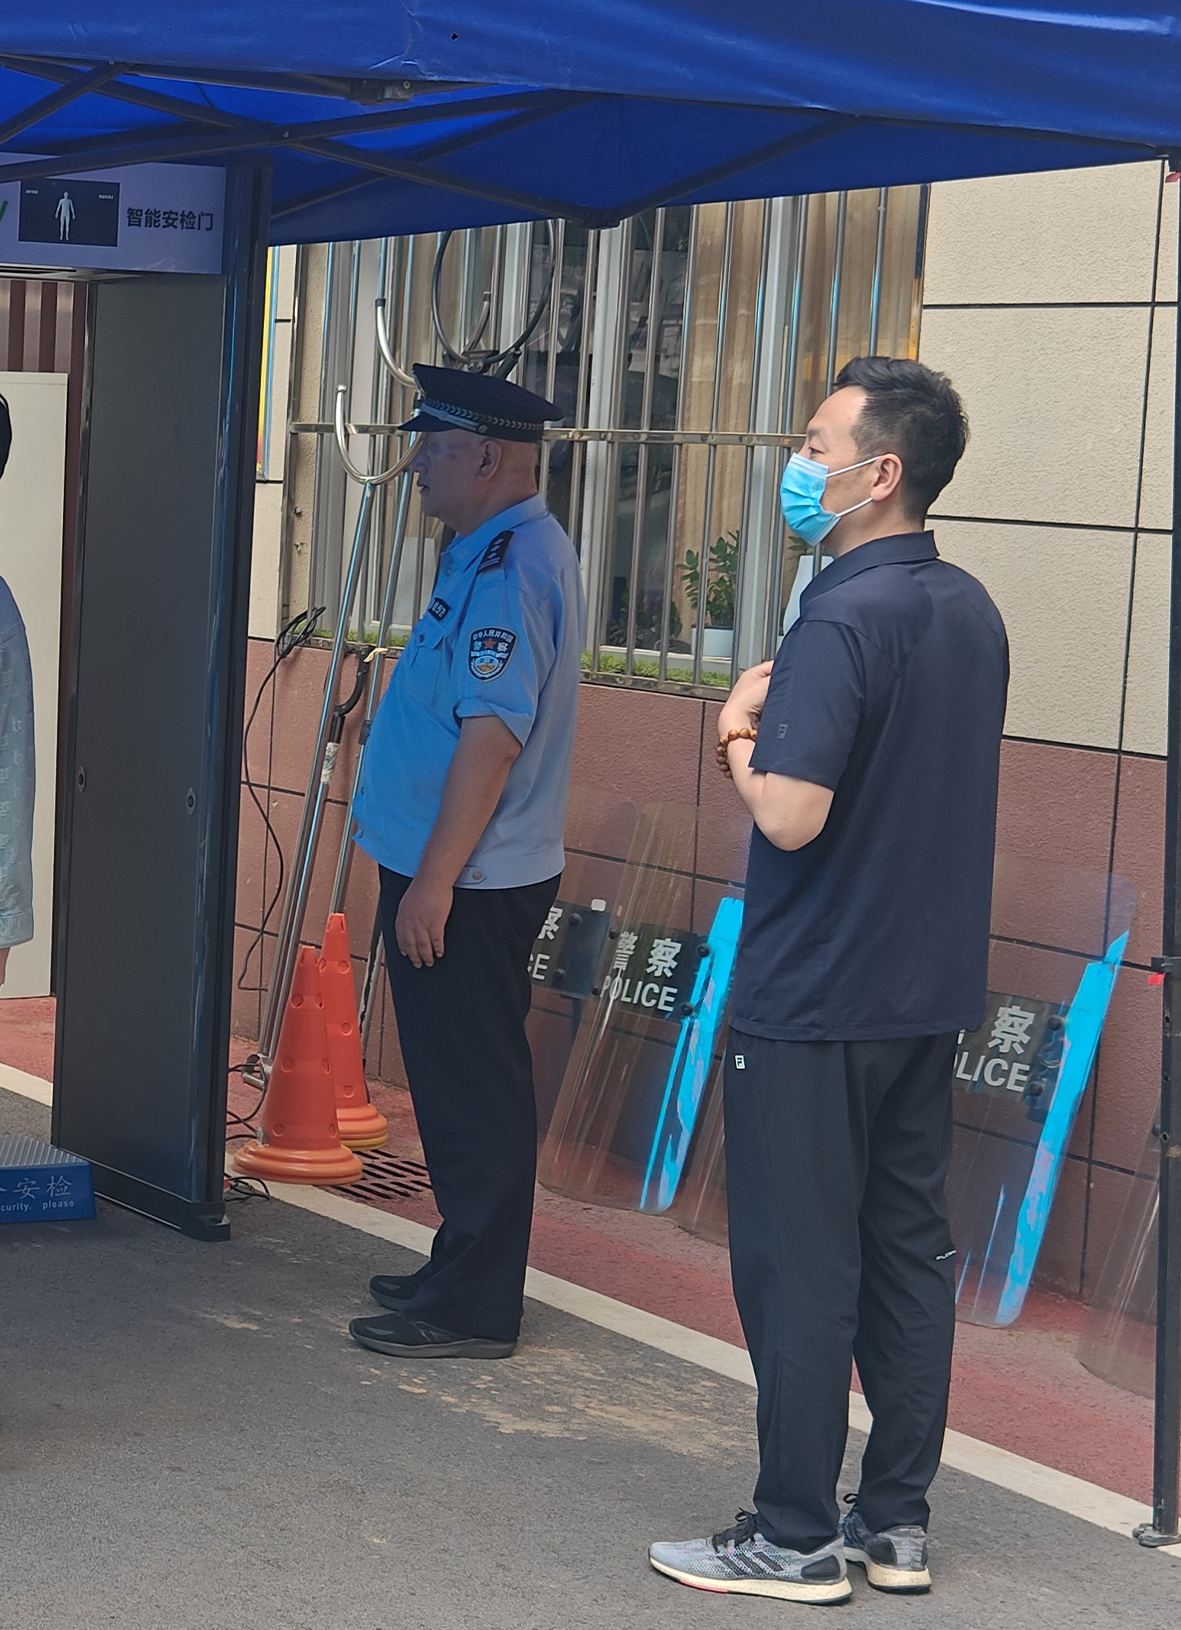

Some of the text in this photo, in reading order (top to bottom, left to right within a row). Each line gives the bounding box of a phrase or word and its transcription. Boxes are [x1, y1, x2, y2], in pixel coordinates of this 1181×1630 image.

[126, 206, 214, 232] 智能安检门
[527, 953, 551, 980] E
[613, 930, 682, 979] 警察
[599, 975, 679, 1013] POLICE
[953, 1051, 1030, 1093] LICE
[42, 1200, 75, 1211] please
